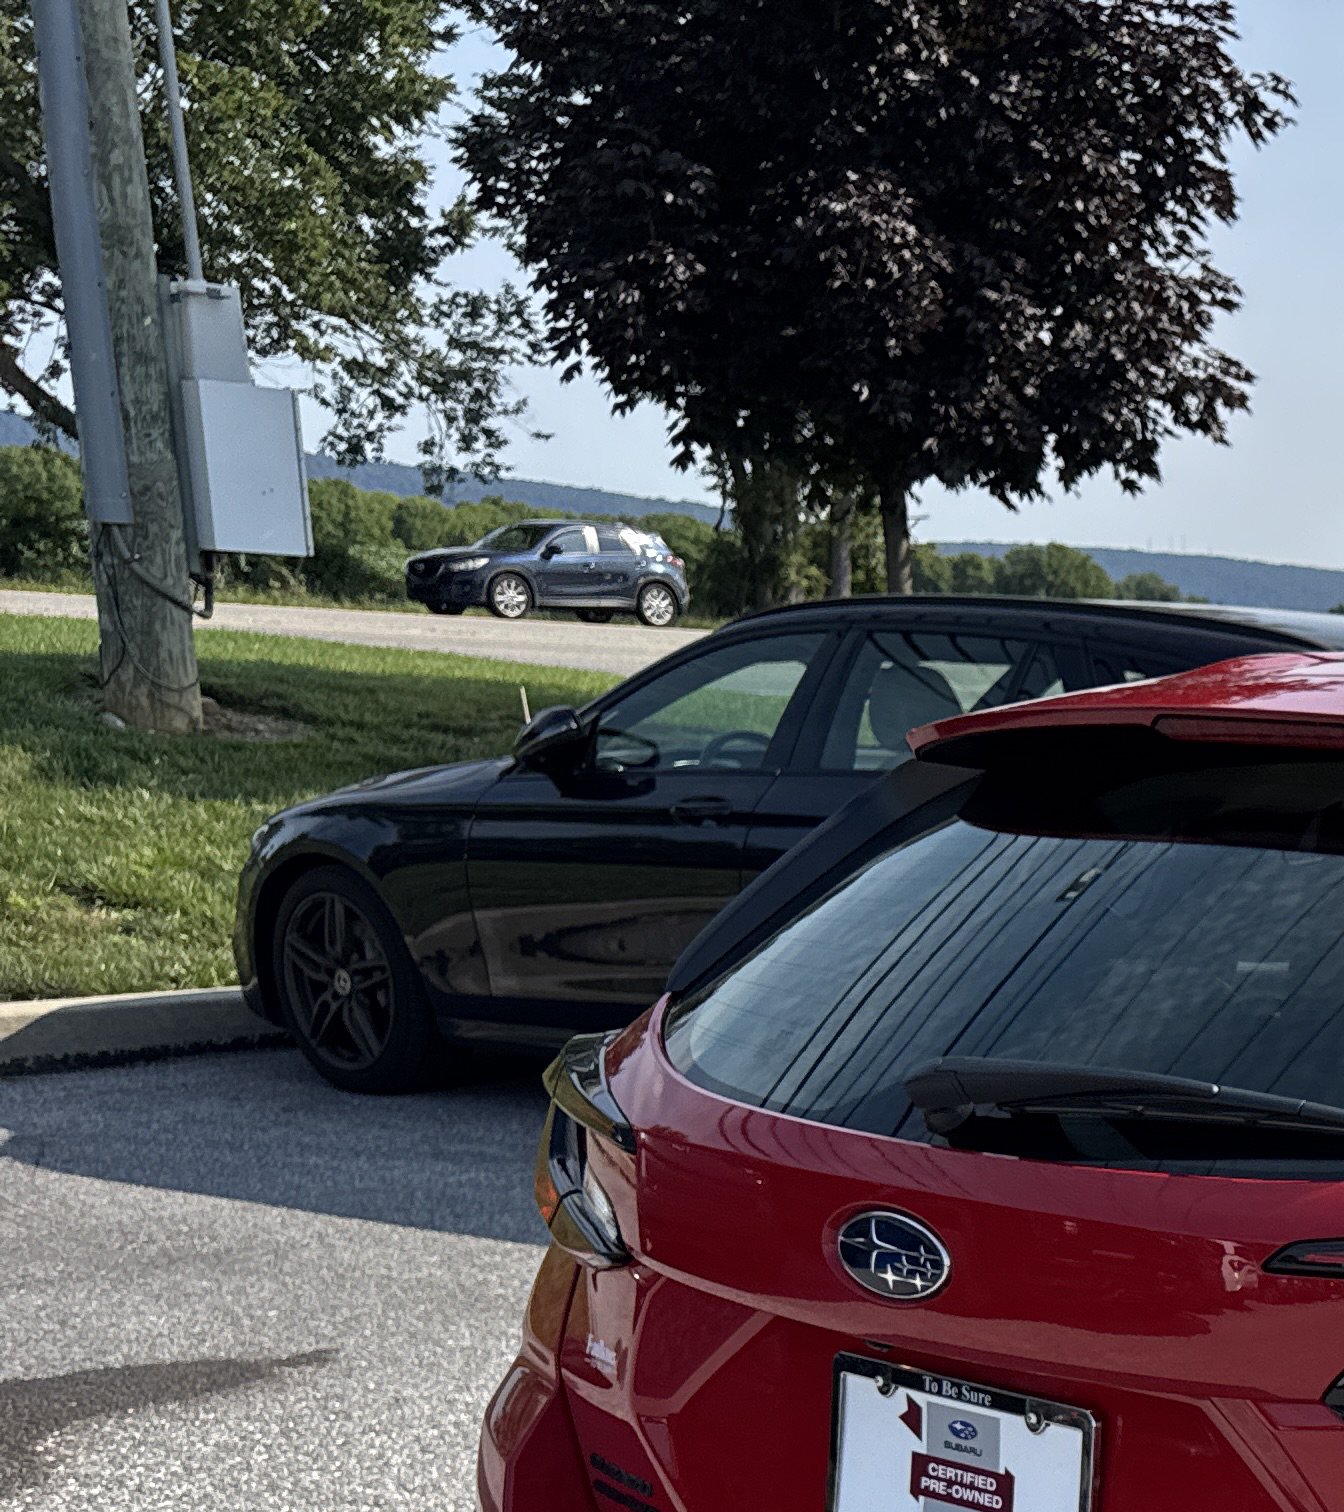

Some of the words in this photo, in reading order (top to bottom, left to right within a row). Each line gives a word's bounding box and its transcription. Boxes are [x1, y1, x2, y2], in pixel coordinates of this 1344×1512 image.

[922, 1375, 939, 1394] To
[941, 1377, 959, 1399] Be
[962, 1386, 992, 1407] Sure
[944, 1440, 982, 1456] SUBARU
[928, 1463, 996, 1491] CERTIFIED
[921, 1477, 1002, 1509] PRE-OWNED
